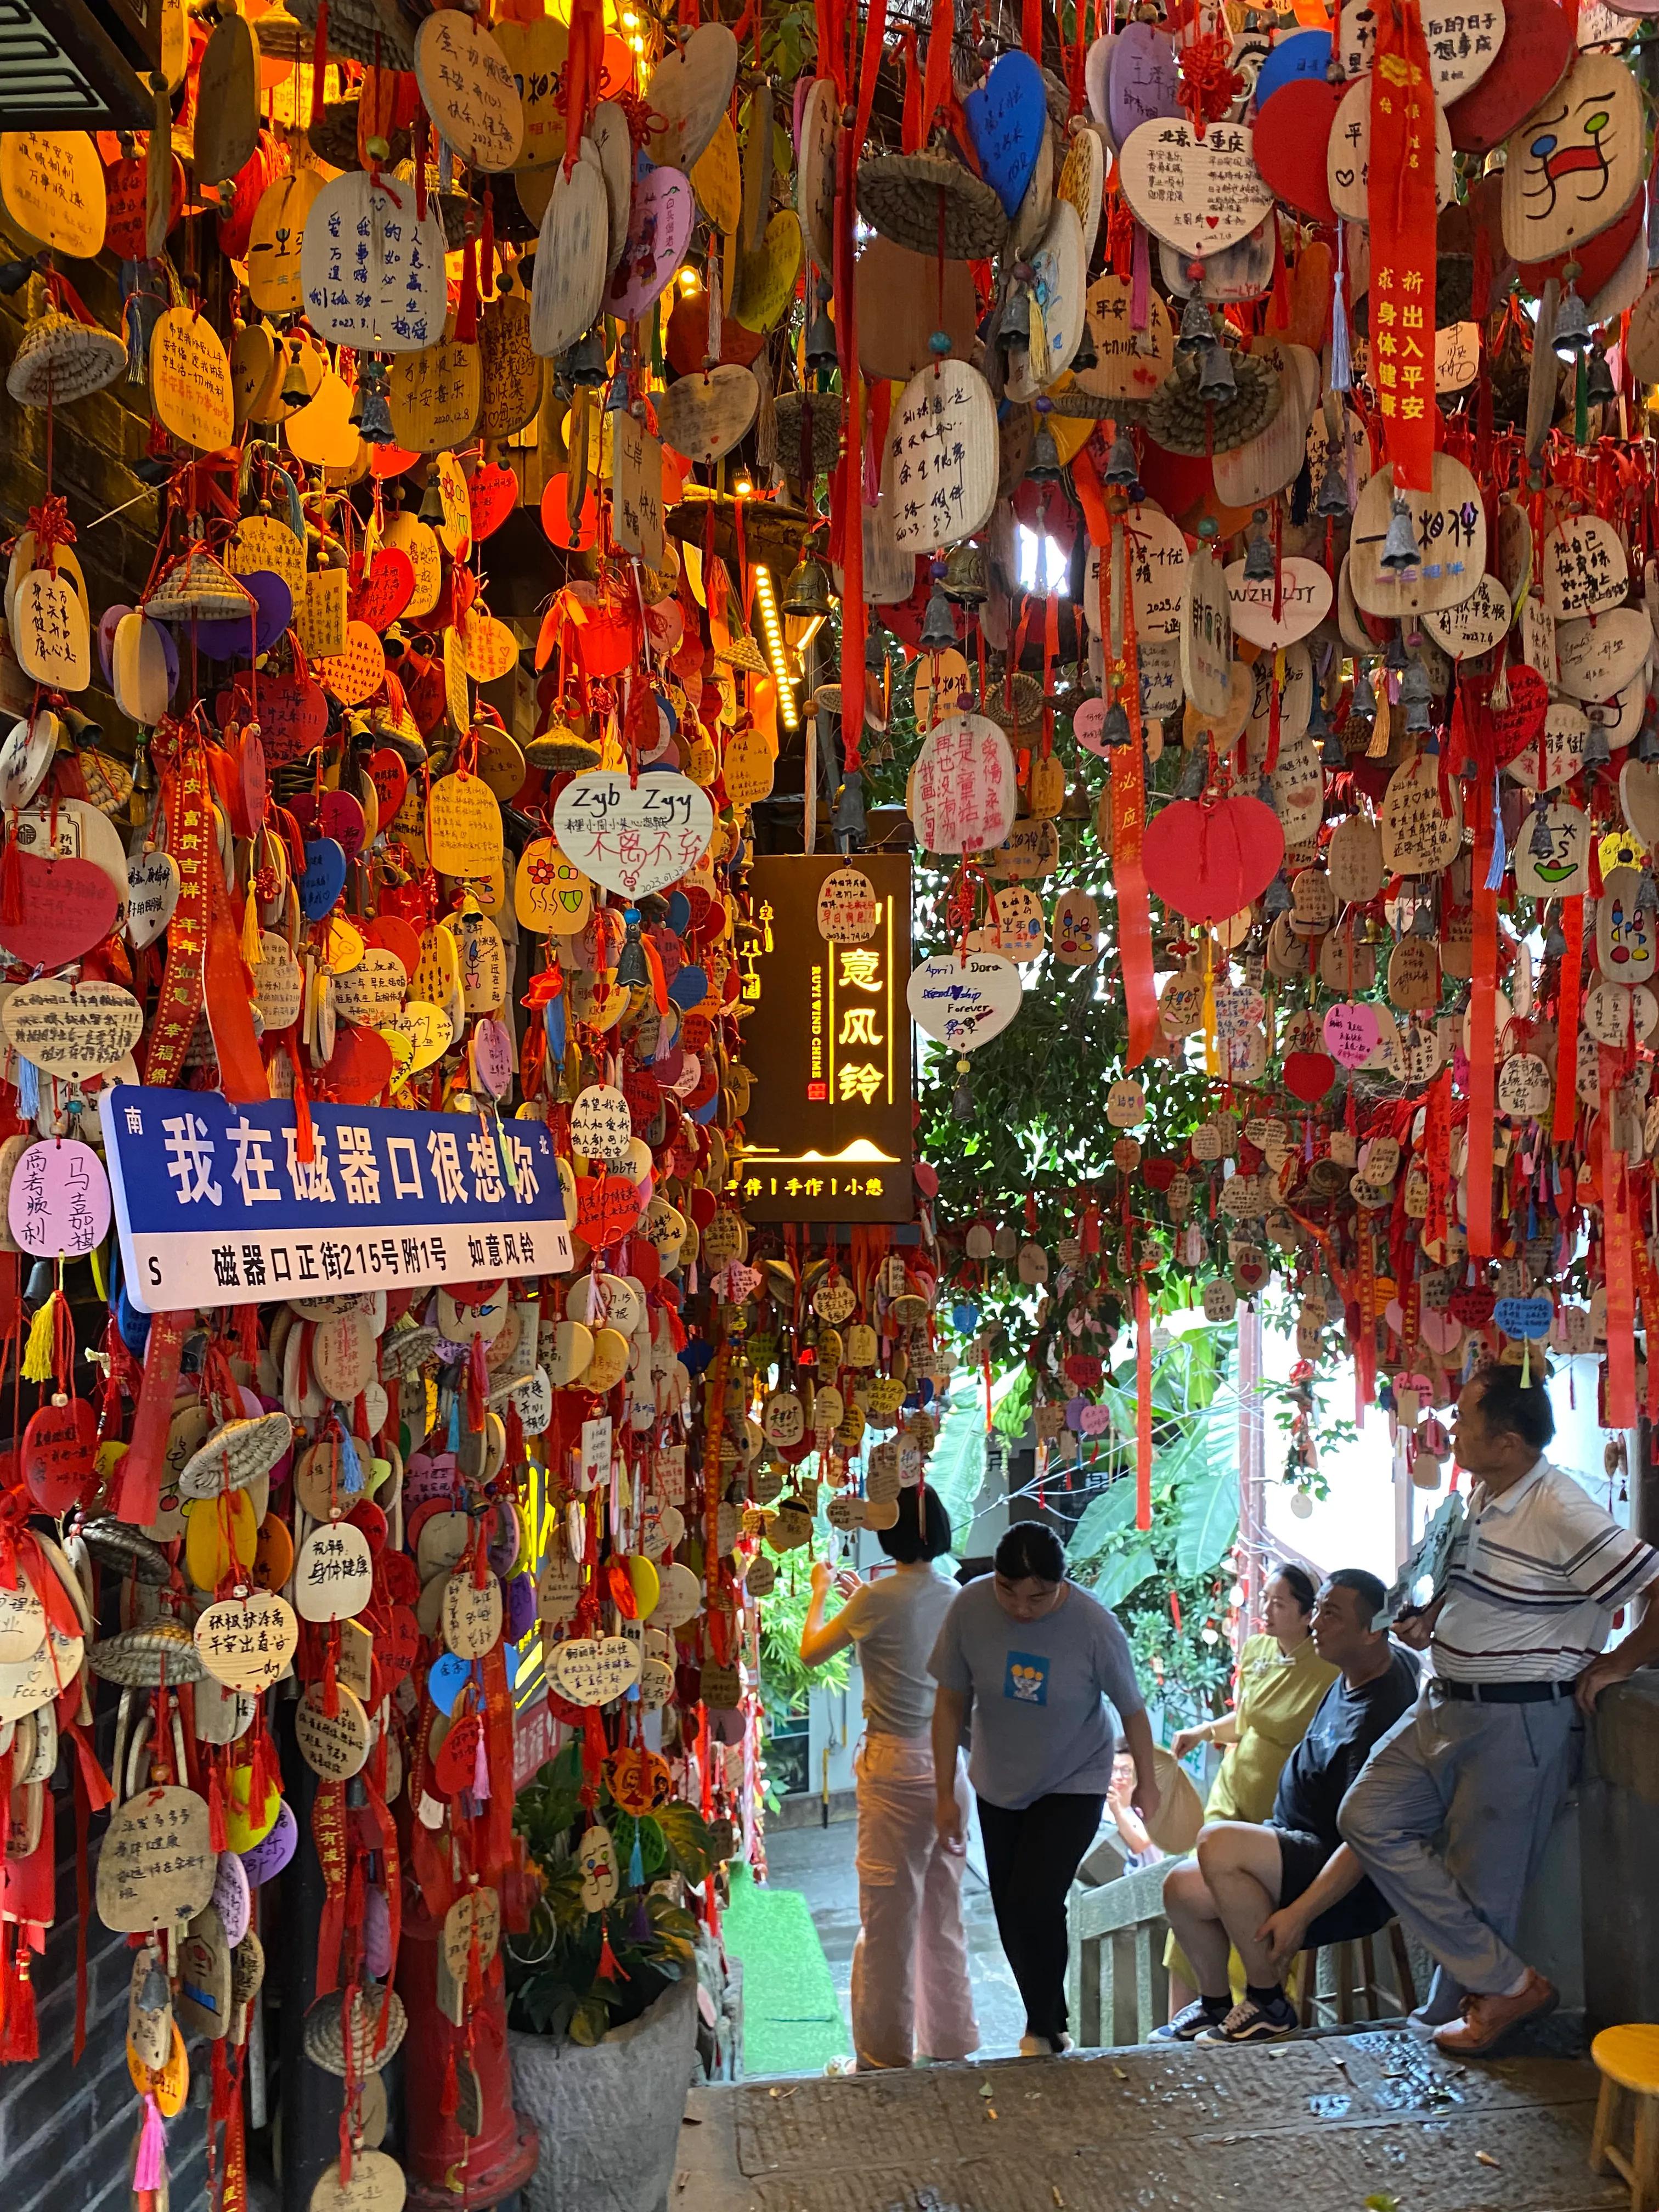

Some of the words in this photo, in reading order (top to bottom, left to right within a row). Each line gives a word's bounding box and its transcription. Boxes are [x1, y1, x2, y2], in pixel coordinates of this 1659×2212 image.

[811, 966, 821, 998] RUYI
[811, 999, 821, 1034] WIND
[838, 948, 884, 1104] 意风铃
[947, 1003, 990, 1013] Forever
[811, 1037, 821, 1079] CHIME
[124, 1105, 143, 1135] 南
[161, 1113, 540, 1206] 我在磁器口很想你
[21, 1148, 53, 1246] 高考顺利
[148, 1256, 162, 1285] S
[212, 1236, 447, 1287] 磁器口正街215号附1号
[467, 1232, 535, 1268] 如意风铃
[557, 1235, 568, 1256] N
